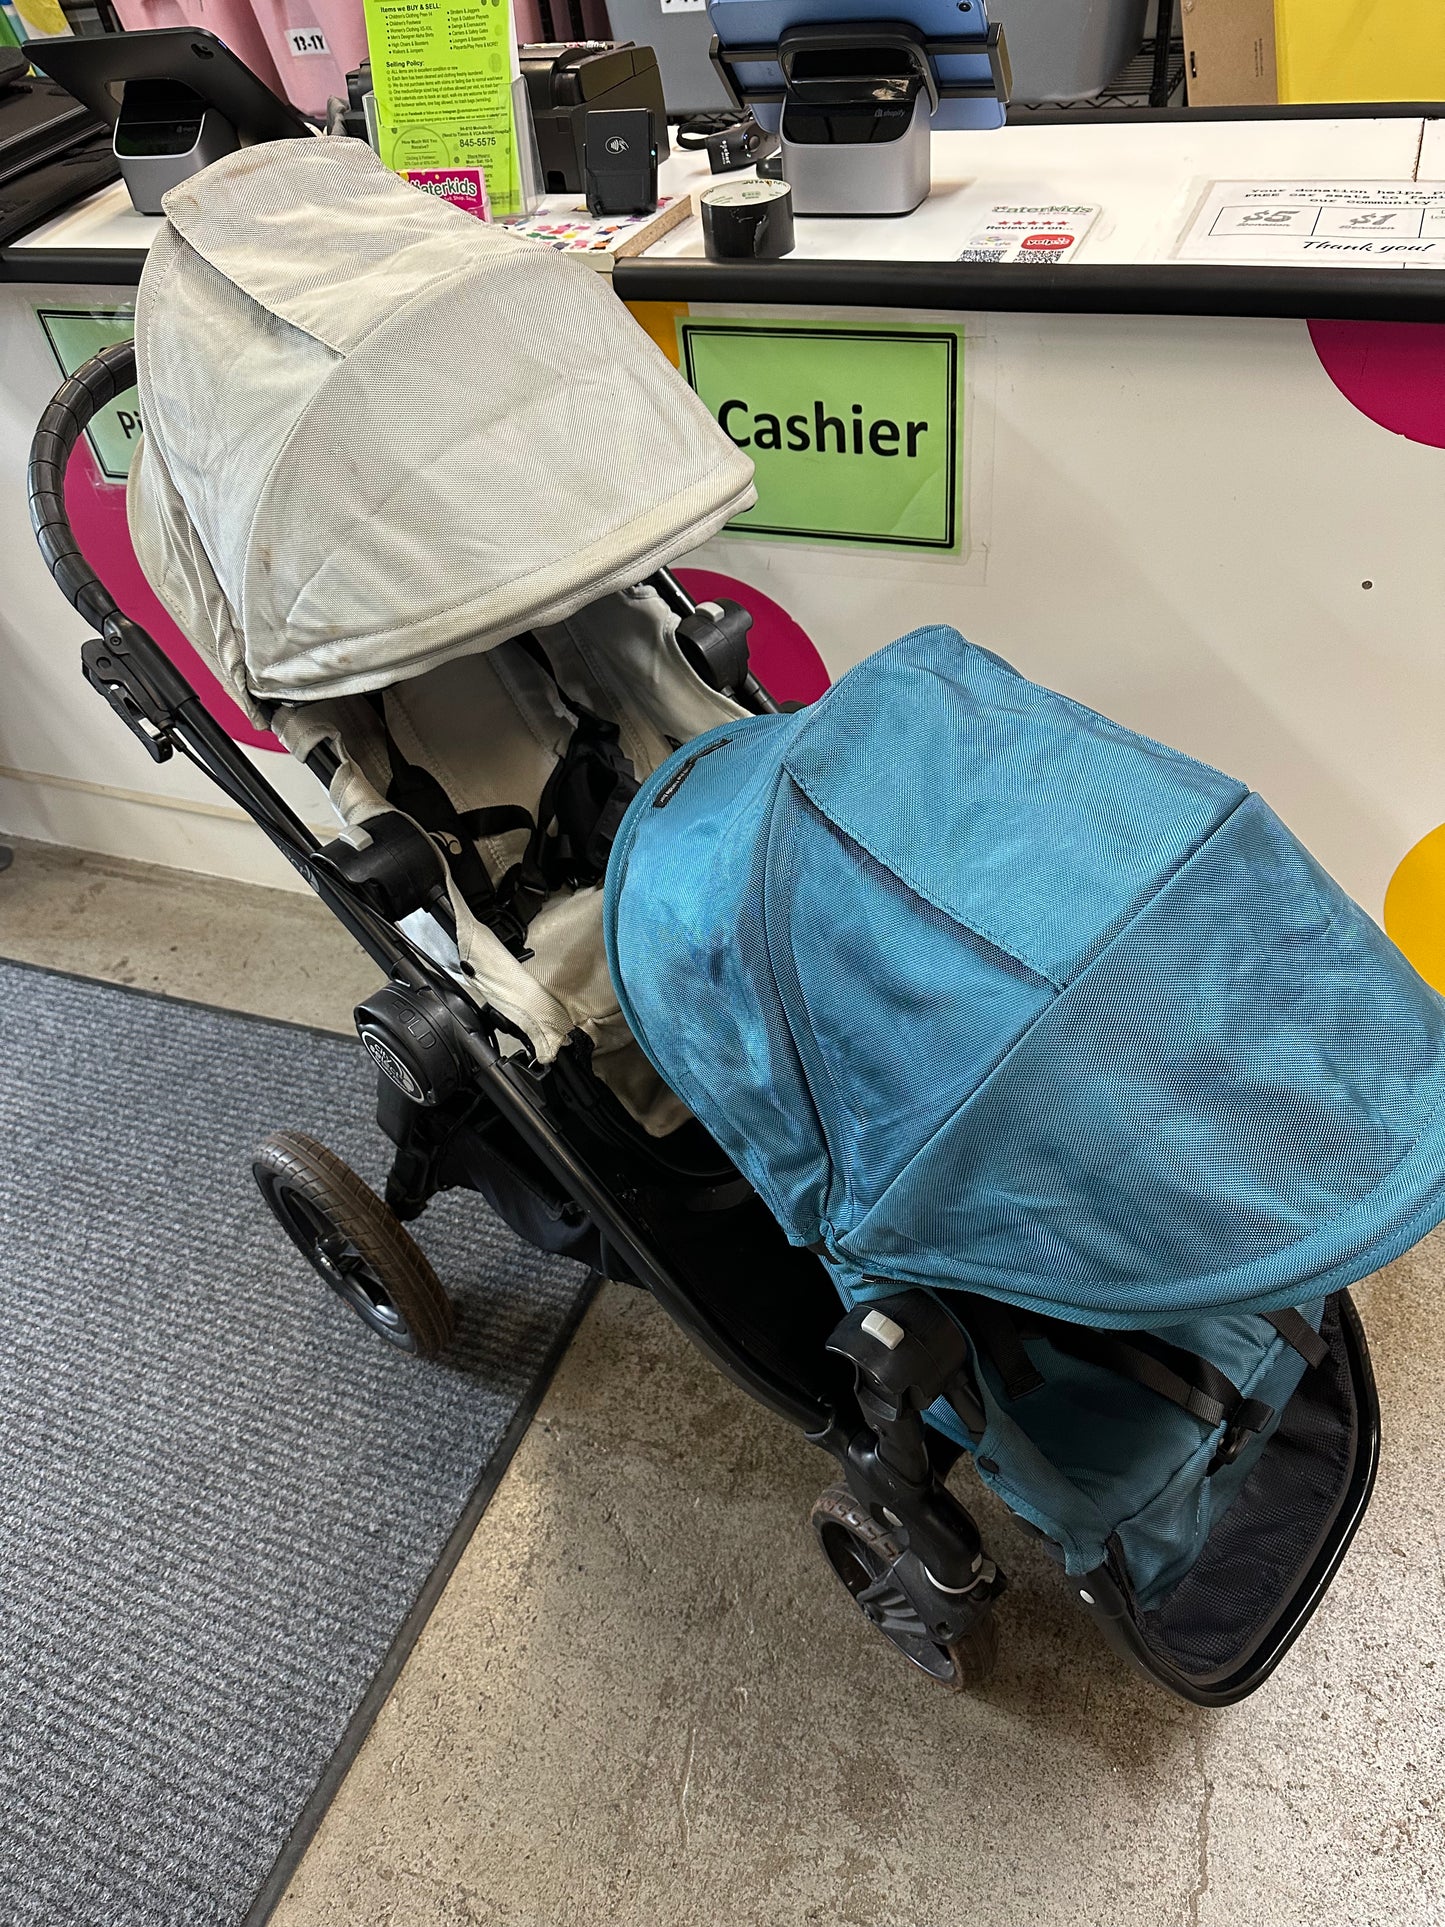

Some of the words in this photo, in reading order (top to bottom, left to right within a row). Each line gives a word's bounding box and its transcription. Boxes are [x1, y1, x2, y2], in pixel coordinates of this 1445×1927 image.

[459, 137, 496, 148] 845-5575
[411, 177, 477, 196] aterkids
[1242, 210, 1301, 222] $5
[1350, 212, 1398, 225] $1
[1302, 240, 1374, 252] Thank
[1374, 243, 1436, 254] you!
[718, 400, 928, 457] Cashier
[393, 1000, 436, 1050] FOLD
